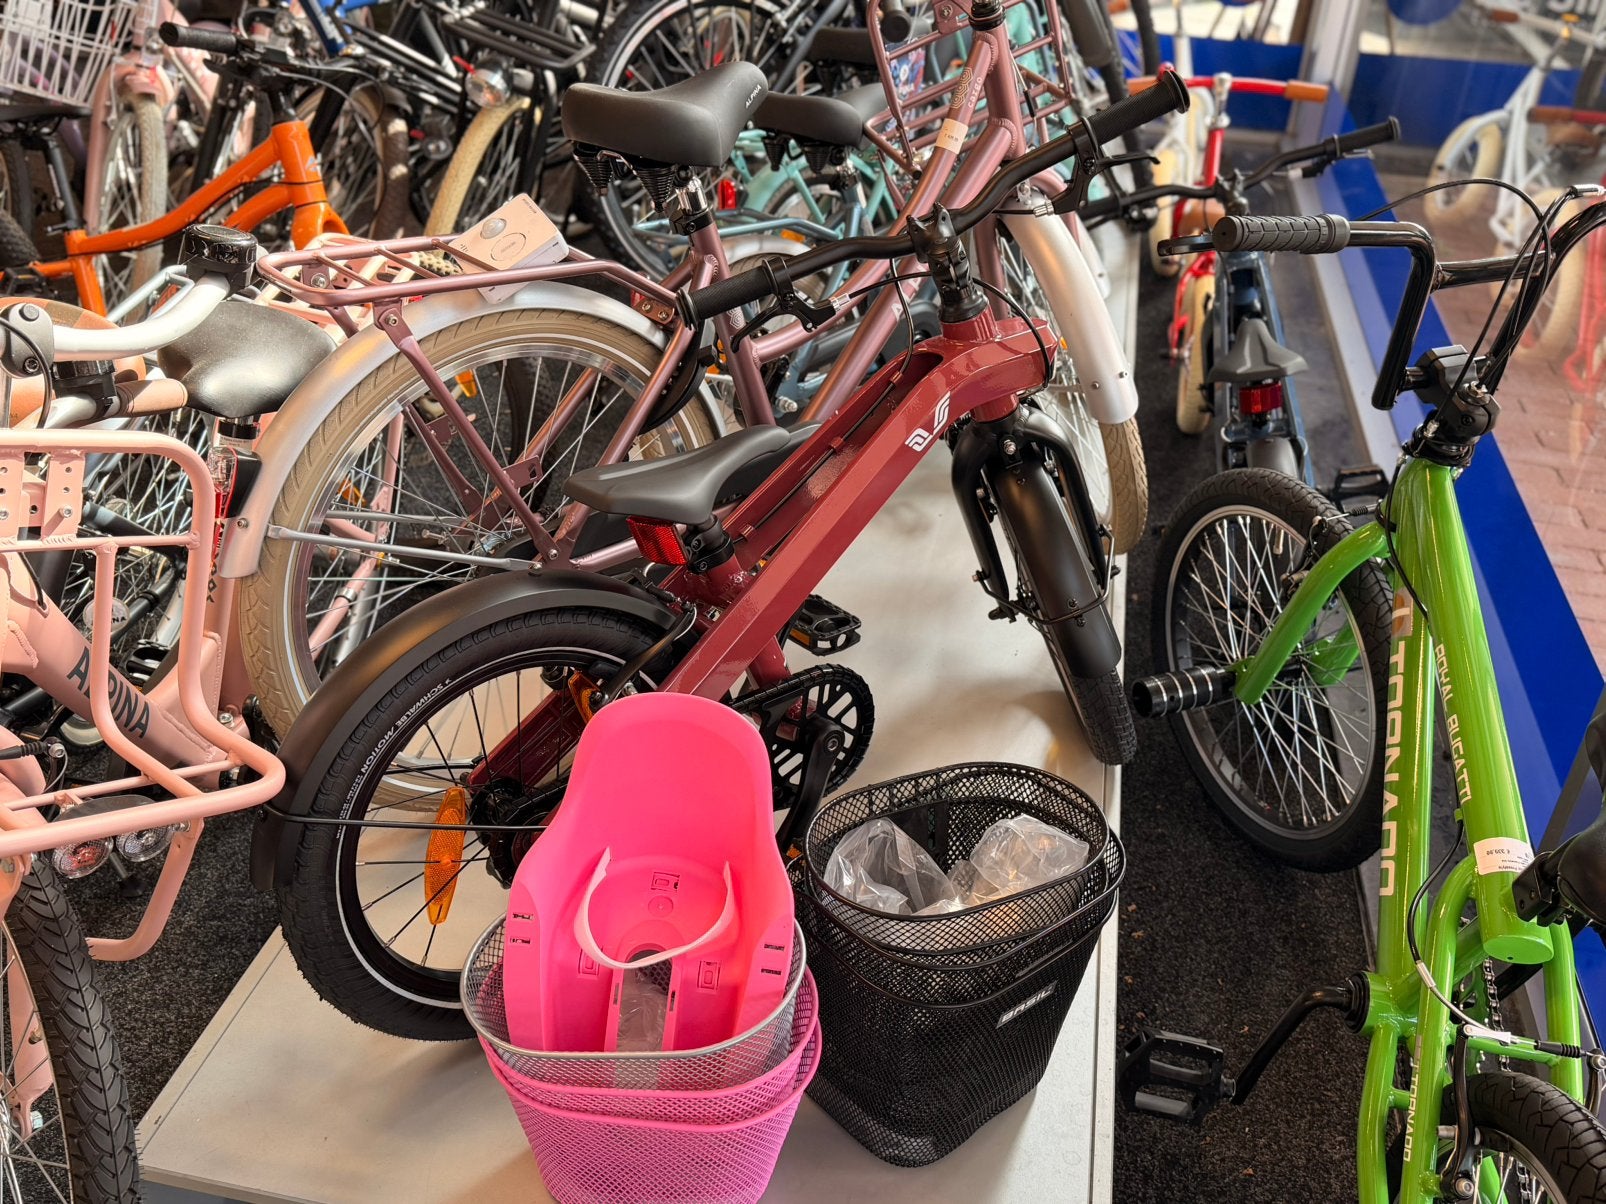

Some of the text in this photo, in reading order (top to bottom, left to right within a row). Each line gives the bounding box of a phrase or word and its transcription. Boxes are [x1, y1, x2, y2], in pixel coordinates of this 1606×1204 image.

[745, 84, 761, 109] ALPINA
[66, 645, 150, 739] APINA
[361, 683, 444, 774] SCHWALBE MOTION
[1434, 643, 1473, 805] ROYAL BUGATTI
[1379, 640, 1405, 896] TORNADO
[1001, 990, 1051, 1023] BASIL
[1403, 1073, 1419, 1162] TORNADO
